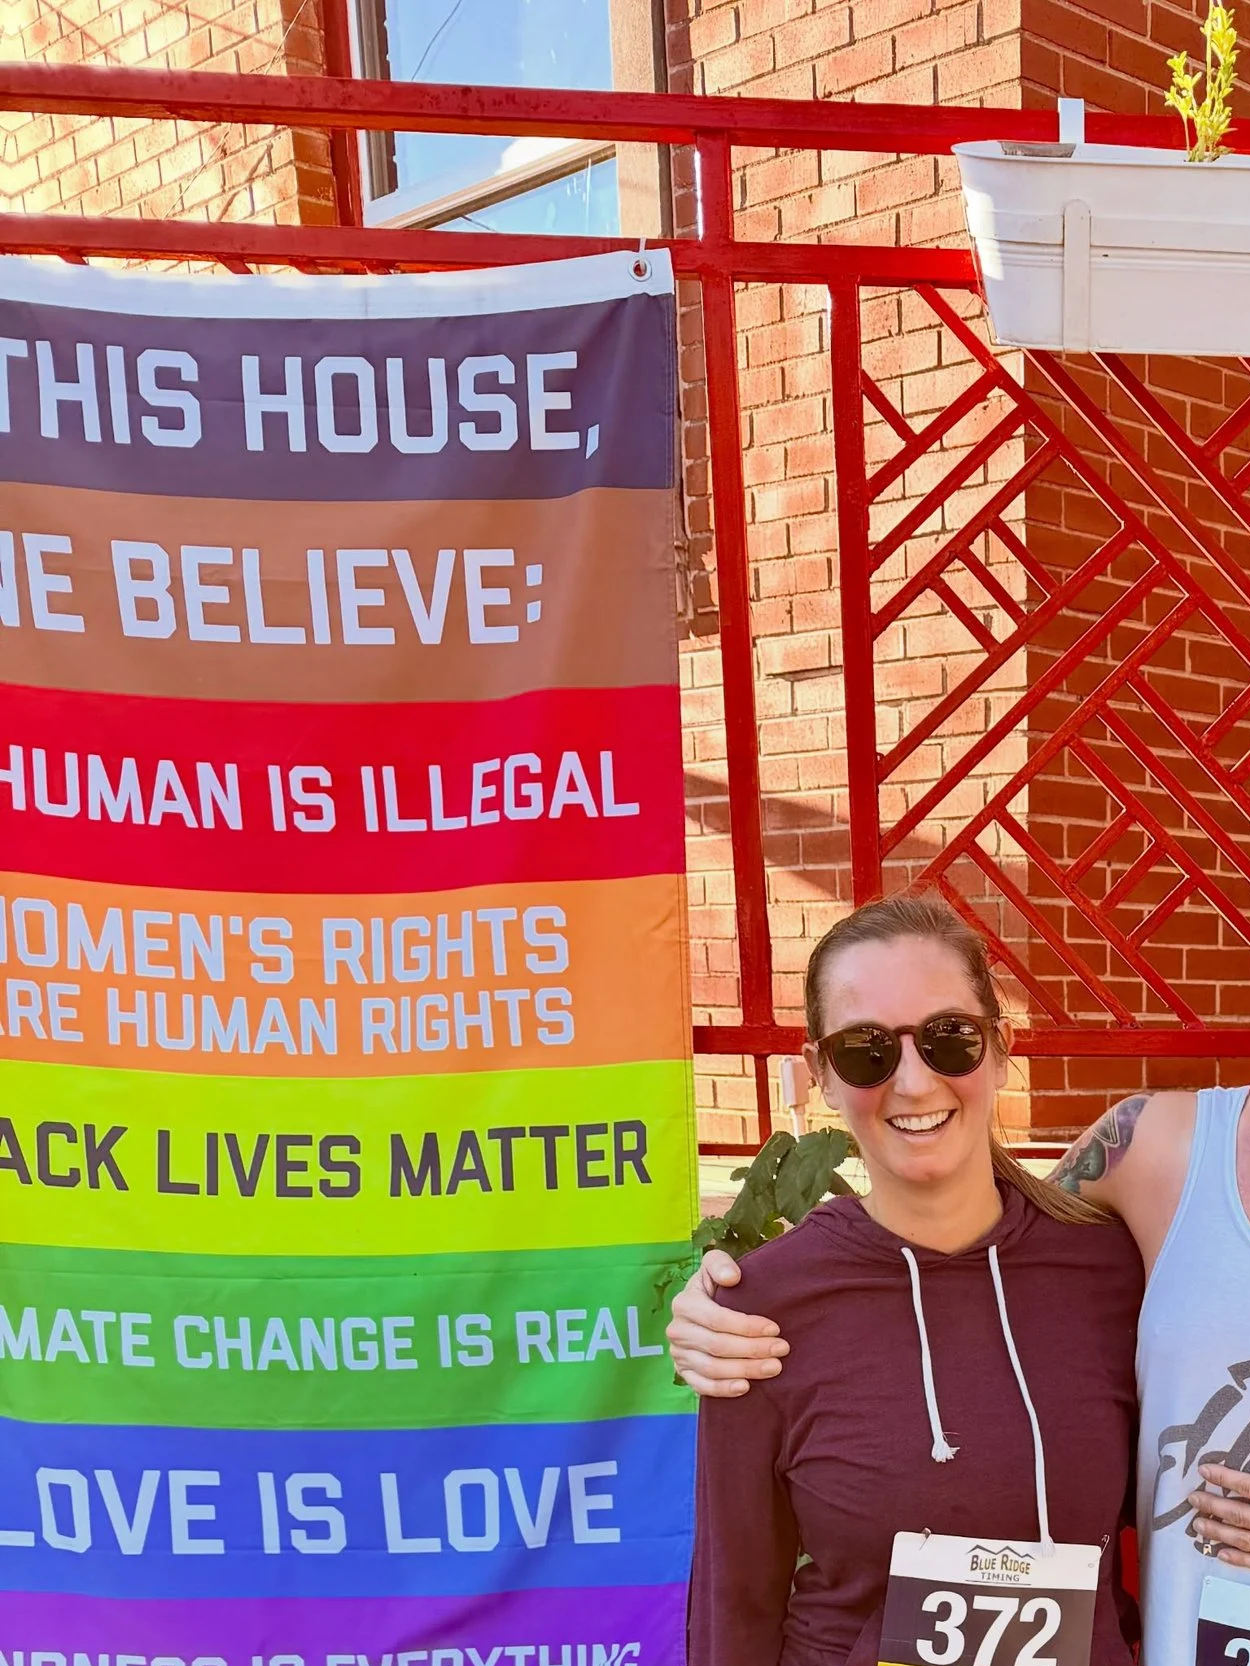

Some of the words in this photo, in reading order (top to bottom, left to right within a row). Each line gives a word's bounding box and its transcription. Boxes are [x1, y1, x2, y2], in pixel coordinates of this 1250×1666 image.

[242, 352, 599, 459] HOUSE,
[111, 540, 542, 644] BELIEVE:
[0, 745, 242, 829] HUMAN
[269, 766, 335, 831] IS
[362, 751, 639, 831] ILLEGAL
[0, 896, 294, 984] OMEN'S
[322, 905, 570, 984] RIGHTS
[0, 979, 84, 1043] RE
[107, 978, 337, 1055] HUMAN
[361, 987, 574, 1054] RIGHTS
[0, 1118, 128, 1190] ACK
[158, 1130, 360, 1197] LIVES
[390, 1120, 652, 1197] MATTER
[0, 1305, 154, 1366] MATE
[174, 1316, 417, 1370] CHANGE
[439, 1315, 493, 1367] IS
[516, 1307, 663, 1362] REAL
[259, 1473, 346, 1553] IS
[381, 1461, 619, 1552] LOVE
[981, 1572, 1021, 1582] TIMING
